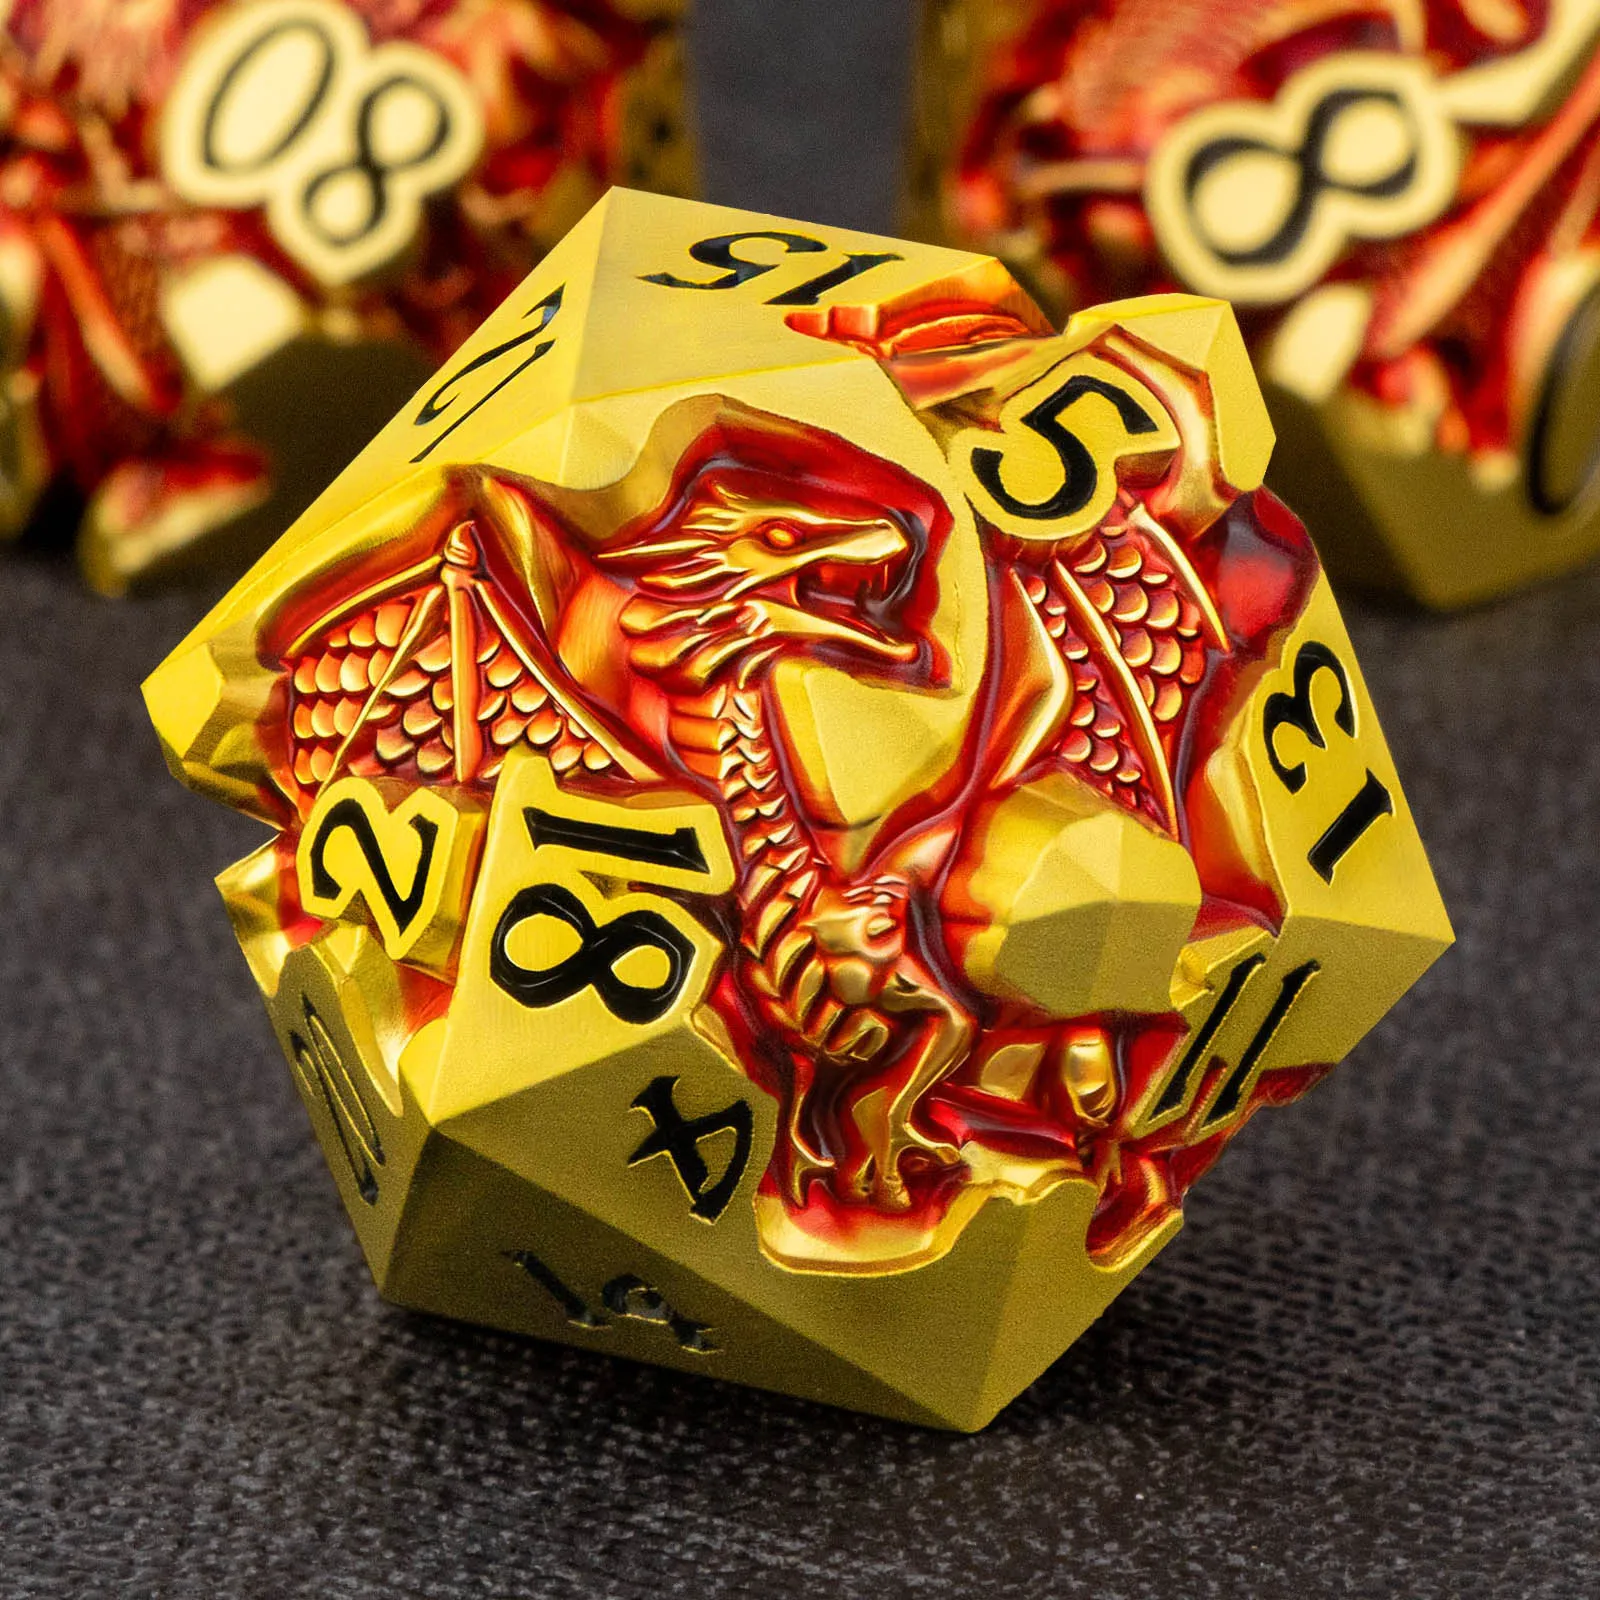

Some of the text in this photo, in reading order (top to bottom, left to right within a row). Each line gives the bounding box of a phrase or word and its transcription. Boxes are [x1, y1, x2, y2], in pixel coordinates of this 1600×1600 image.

[202, 18, 452, 247] 80
[1183, 88, 1419, 266] 8
[637, 232, 904, 305] 15
[409, 283, 566, 463] 12
[971, 375, 1158, 520] 5
[1263, 641, 1393, 885] 13
[310, 798, 438, 936] 2
[490, 807, 710, 1024] 18
[1149, 952, 1320, 1131] 11
[627, 1076, 753, 1221] 4
